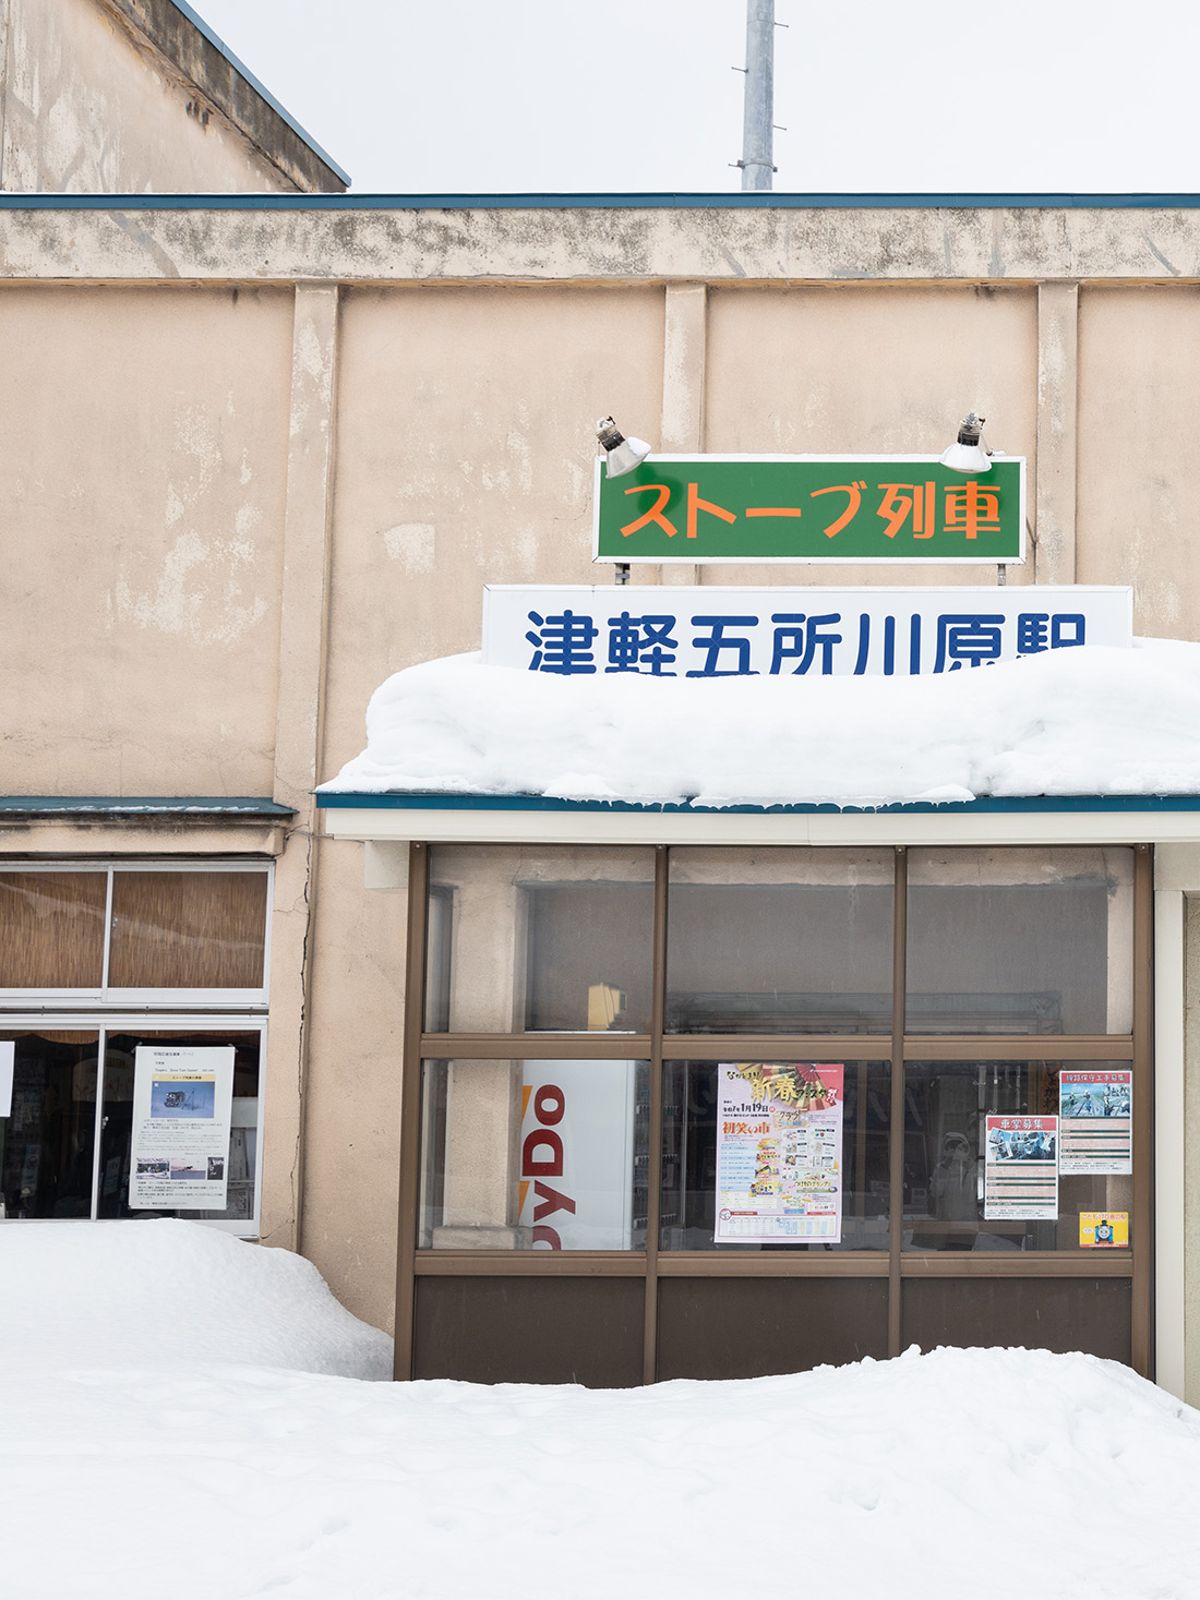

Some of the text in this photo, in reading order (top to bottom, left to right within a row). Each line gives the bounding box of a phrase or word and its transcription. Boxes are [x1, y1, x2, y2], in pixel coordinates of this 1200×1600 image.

[619, 480, 1001, 539] ストーブ列車
